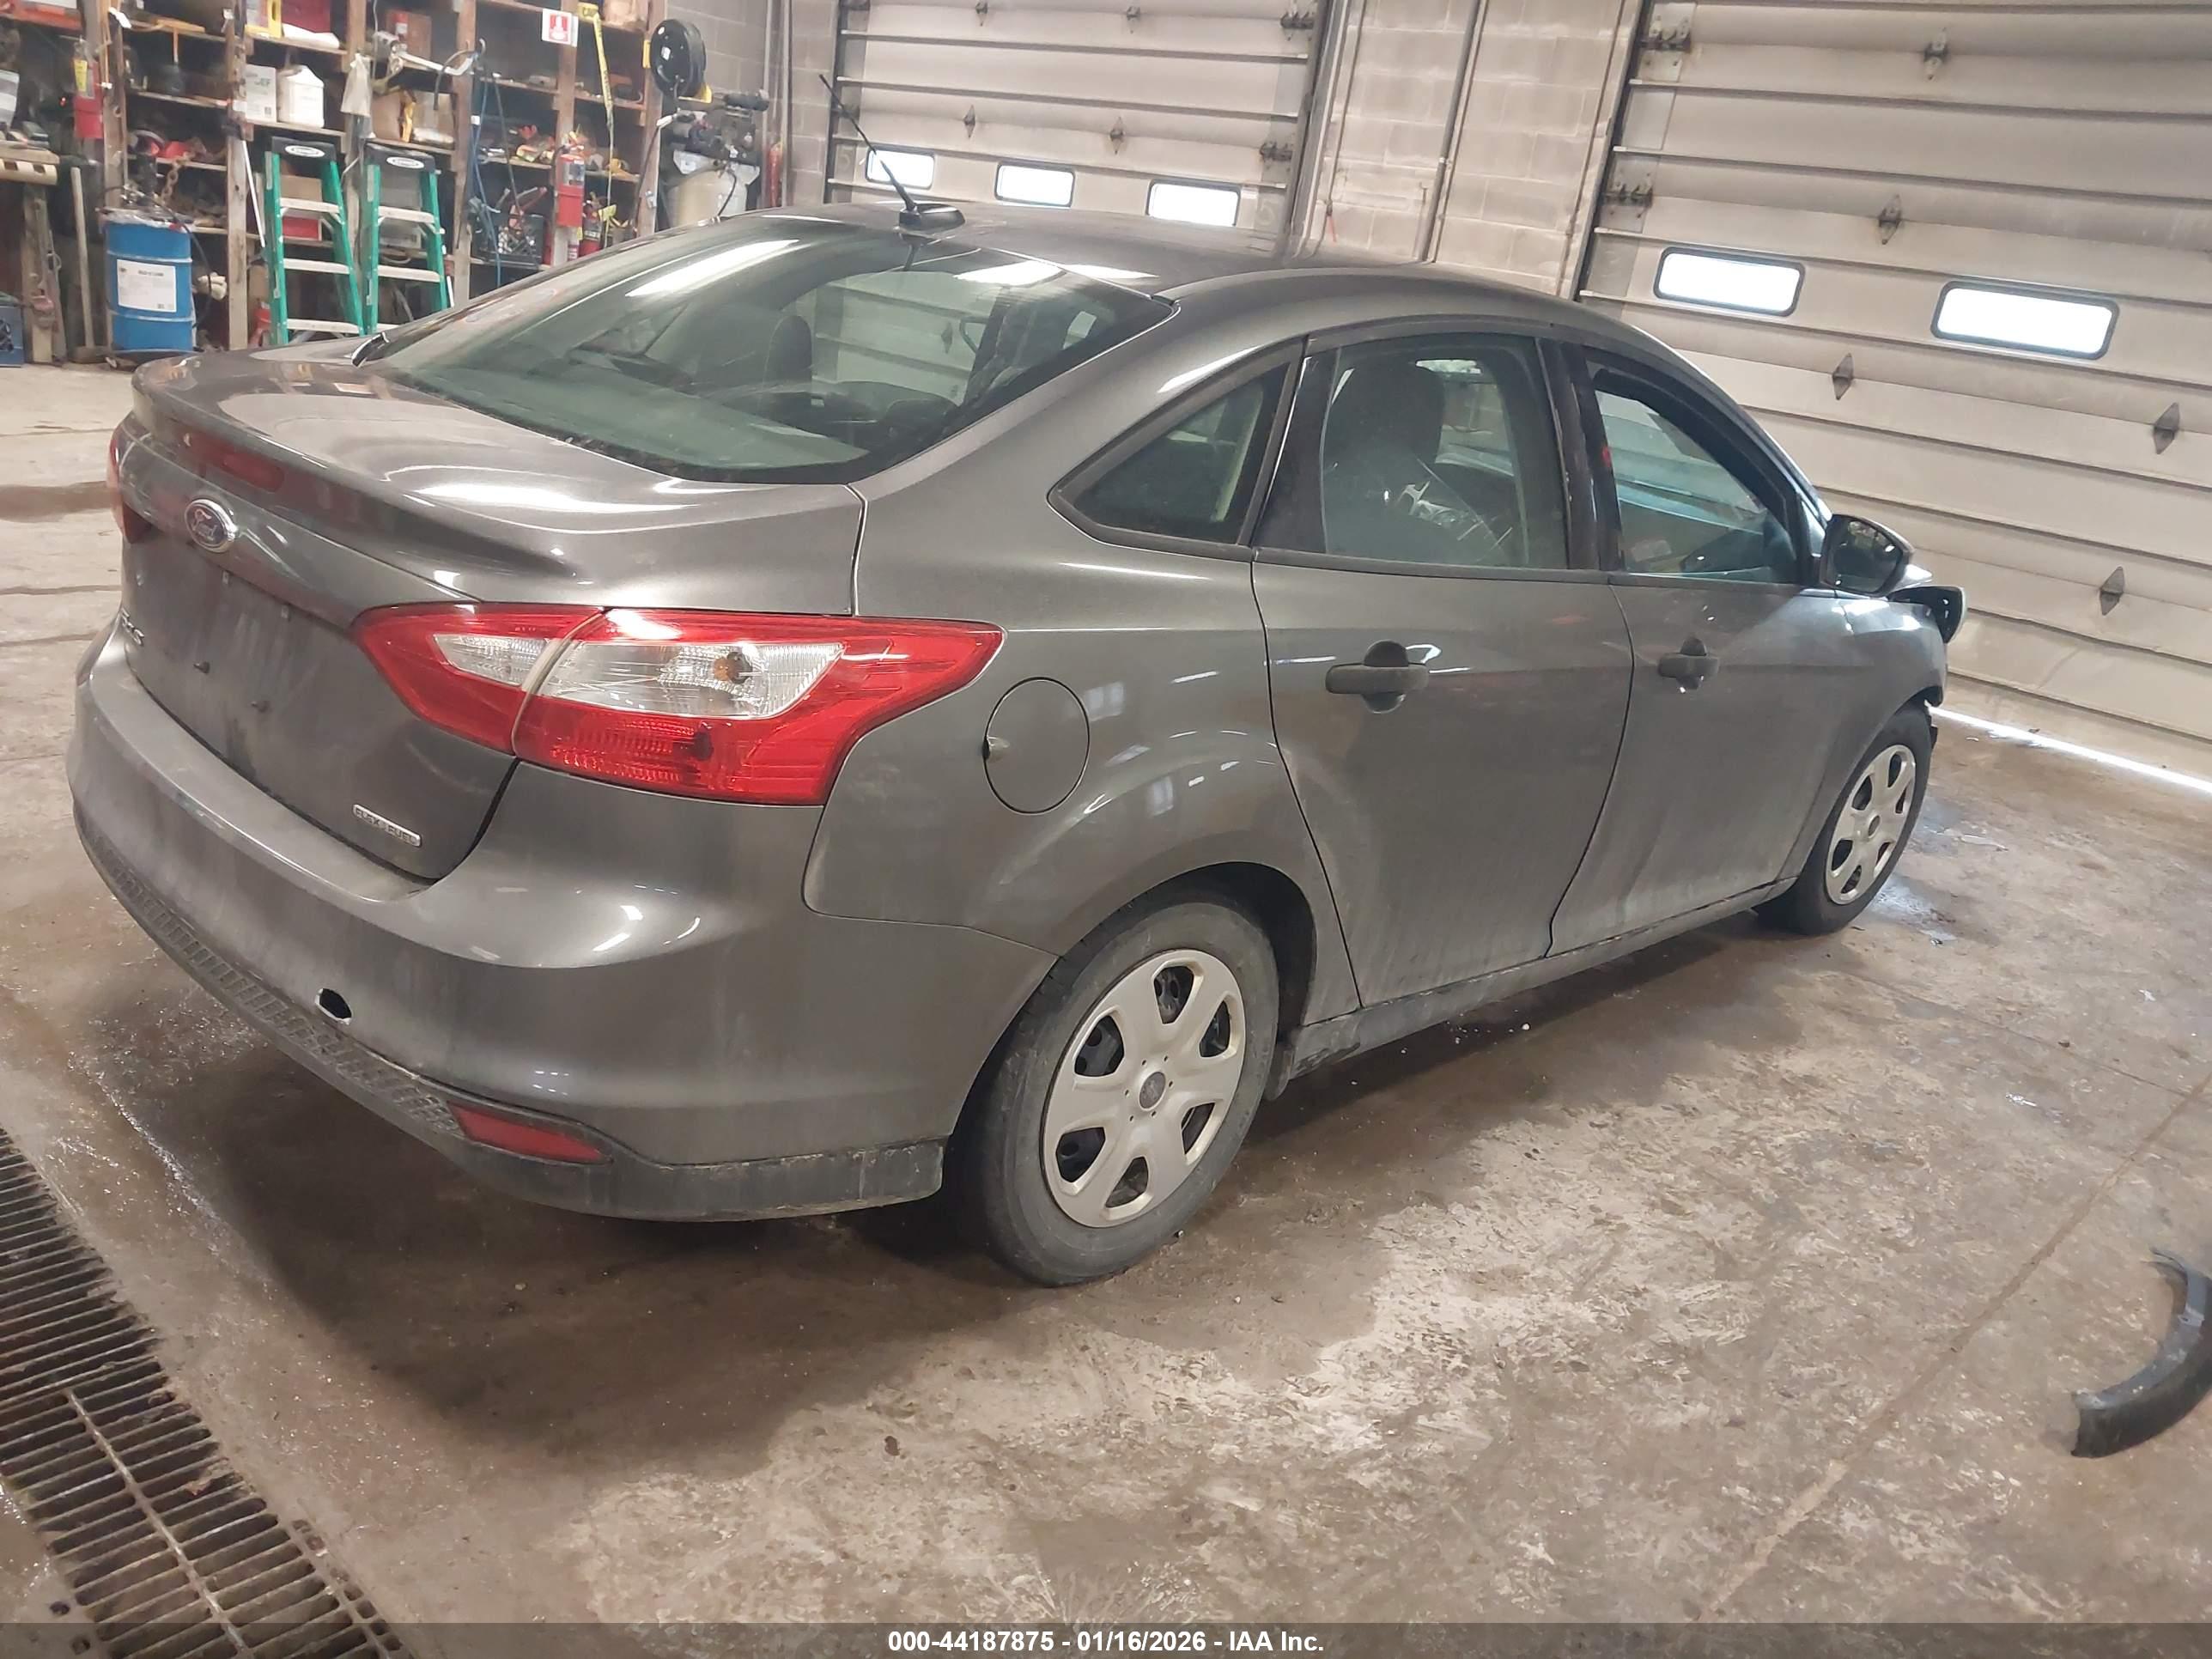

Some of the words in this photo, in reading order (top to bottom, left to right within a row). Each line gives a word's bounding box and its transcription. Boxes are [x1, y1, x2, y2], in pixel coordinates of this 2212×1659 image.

[191, 507, 218, 542] Ford
[355, 807, 380, 826] FLEX
[386, 823, 419, 846] FUEL
